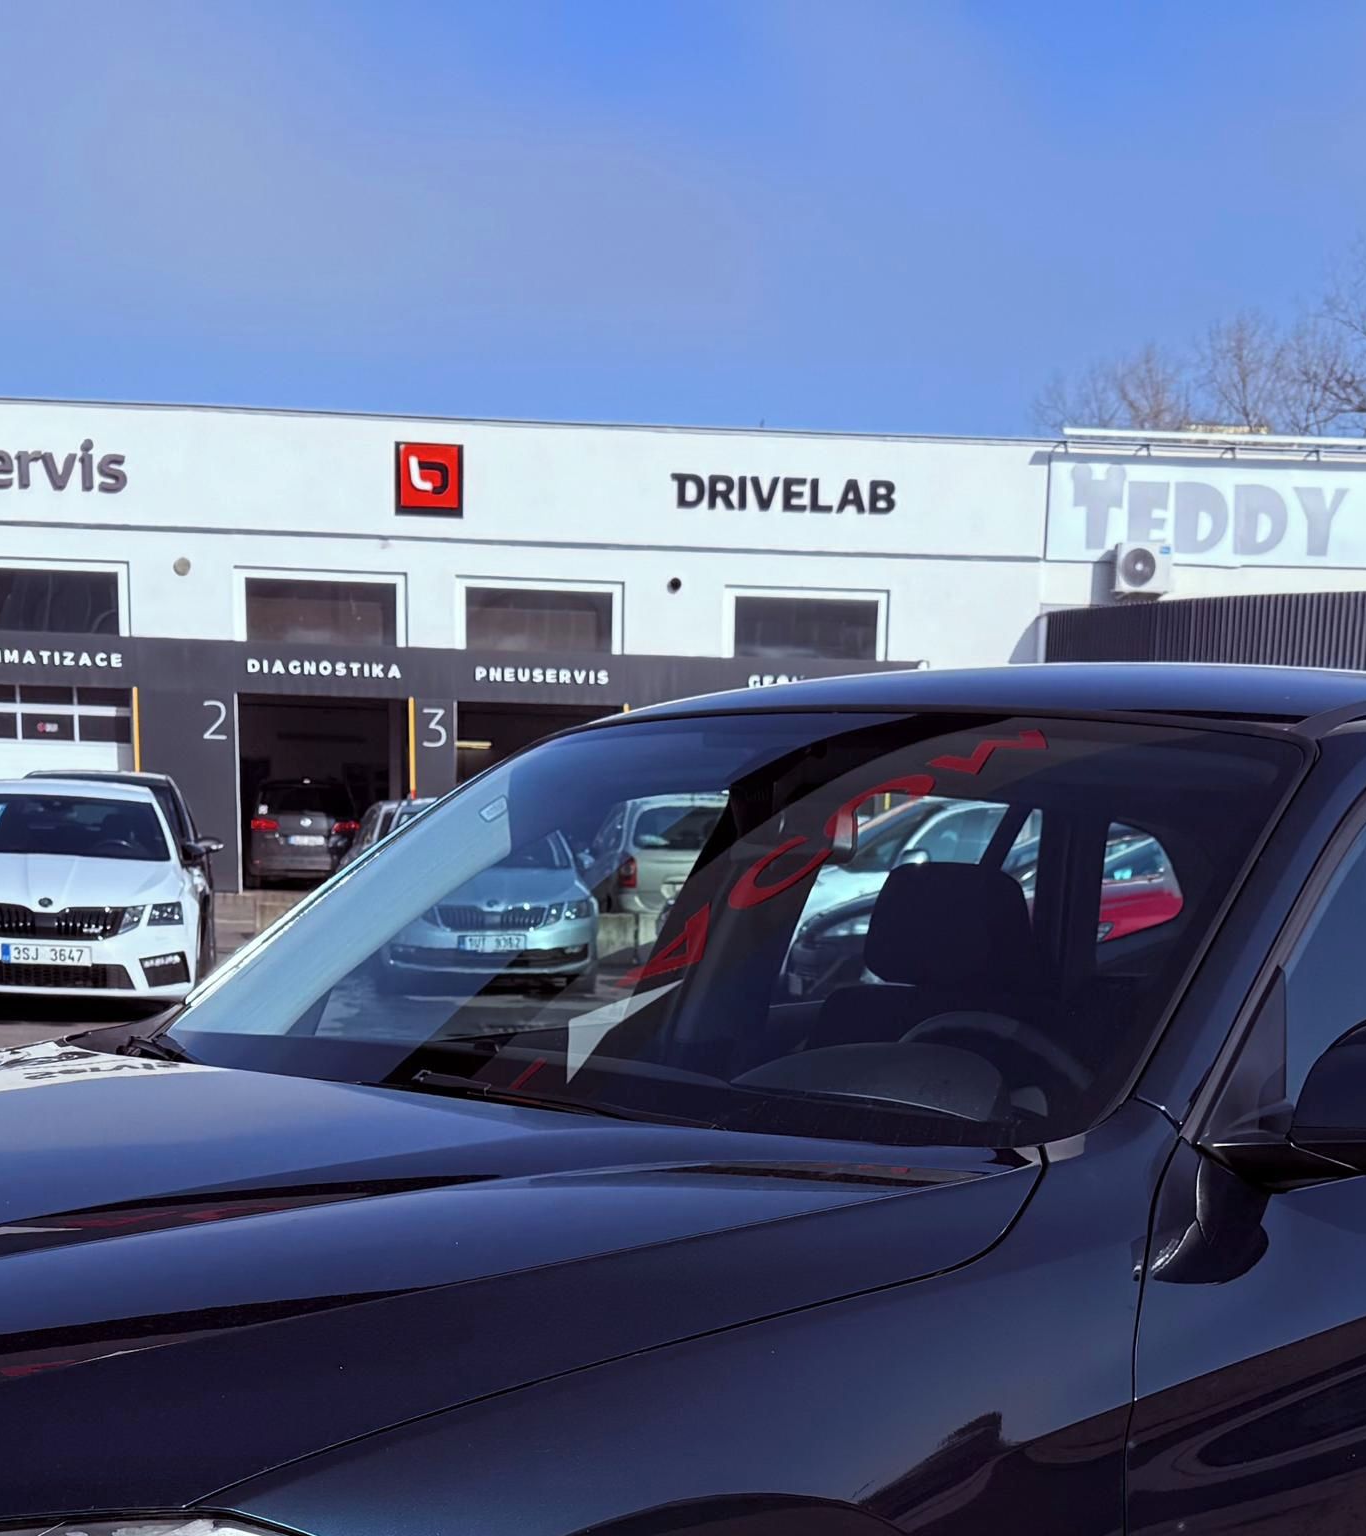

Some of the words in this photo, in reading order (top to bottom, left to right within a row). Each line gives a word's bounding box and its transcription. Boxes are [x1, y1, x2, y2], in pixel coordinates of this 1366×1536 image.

[671, 472, 897, 515] DRIVELAB
[1070, 462, 1349, 557] TEDDY
[246, 657, 403, 680] DIAGNOSTIKA
[474, 665, 610, 686] PNEUSERVIS
[202, 700, 228, 740] 2
[422, 708, 447, 748] 3
[13, 946, 40, 961] 3SJ
[49, 948, 84, 963] 3647
